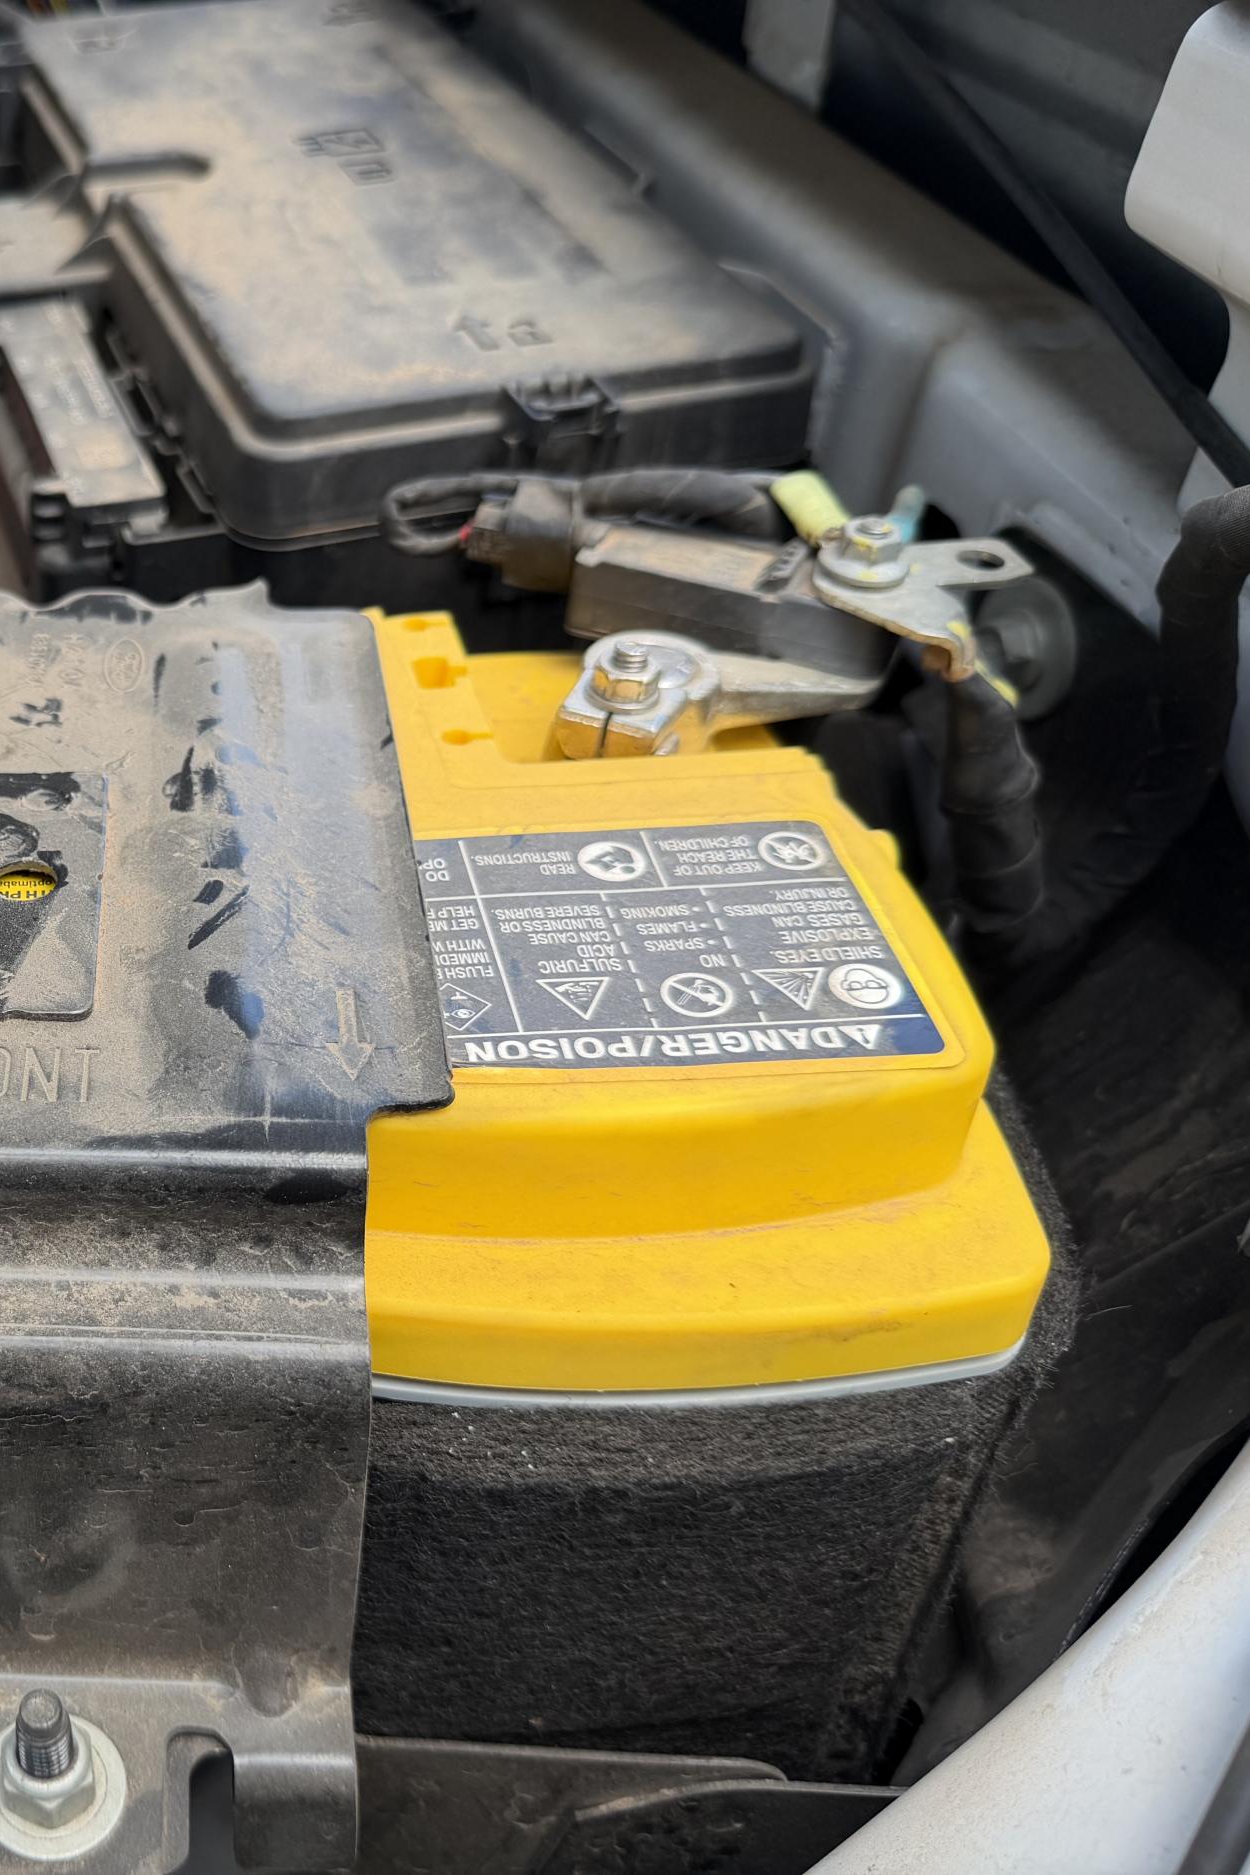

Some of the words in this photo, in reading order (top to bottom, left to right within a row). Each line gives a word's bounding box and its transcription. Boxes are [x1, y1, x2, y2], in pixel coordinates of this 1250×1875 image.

[654, 837, 729, 851] CHILDREN.
[728, 835, 749, 847] OF
[470, 850, 572, 866] INSTRUCTIONS.
[676, 851, 725, 863] REACH
[724, 849, 756, 861] THE
[539, 863, 577, 875] READ
[672, 865, 692, 876] OF
[691, 864, 723, 876] OUT
[723, 861, 761, 875] KEEP
[425, 870, 450, 882] DO
[769, 888, 827, 901] INJURY.
[826, 887, 848, 898] OR
[438, 905, 475, 918] HELP
[544, 905, 600, 918] SEVERE
[620, 904, 690, 919] SMOKING
[723, 902, 805, 917] BLINDNESS
[804, 899, 857, 913] CAUSE
[490, 909, 544, 920] BURNS.
[806, 912, 864, 927] GASES
[450, 918, 479, 930] GET
[498, 921, 521, 933] OR
[521, 917, 605, 932] BLINDNESS
[636, 921, 698, 935] FLAMES
[771, 915, 804, 928] CAN
[527, 932, 578, 945] CAUSE
[579, 930, 610, 942] CAN
[778, 927, 874, 944] EXPLOSIVE
[446, 938, 485, 952] WITH
[576, 944, 615, 958] ACID
[644, 938, 704, 952] SPARKS
[434, 952, 489, 965] IMMEDI
[769, 949, 821, 963] EYES.
[821, 945, 884, 962] SHIELD
[538, 958, 622, 974] SULFURIC
[699, 954, 725, 968] NO
[445, 966, 493, 978] FLUSH
[464, 1026, 846, 1062] DANGER/POISON
